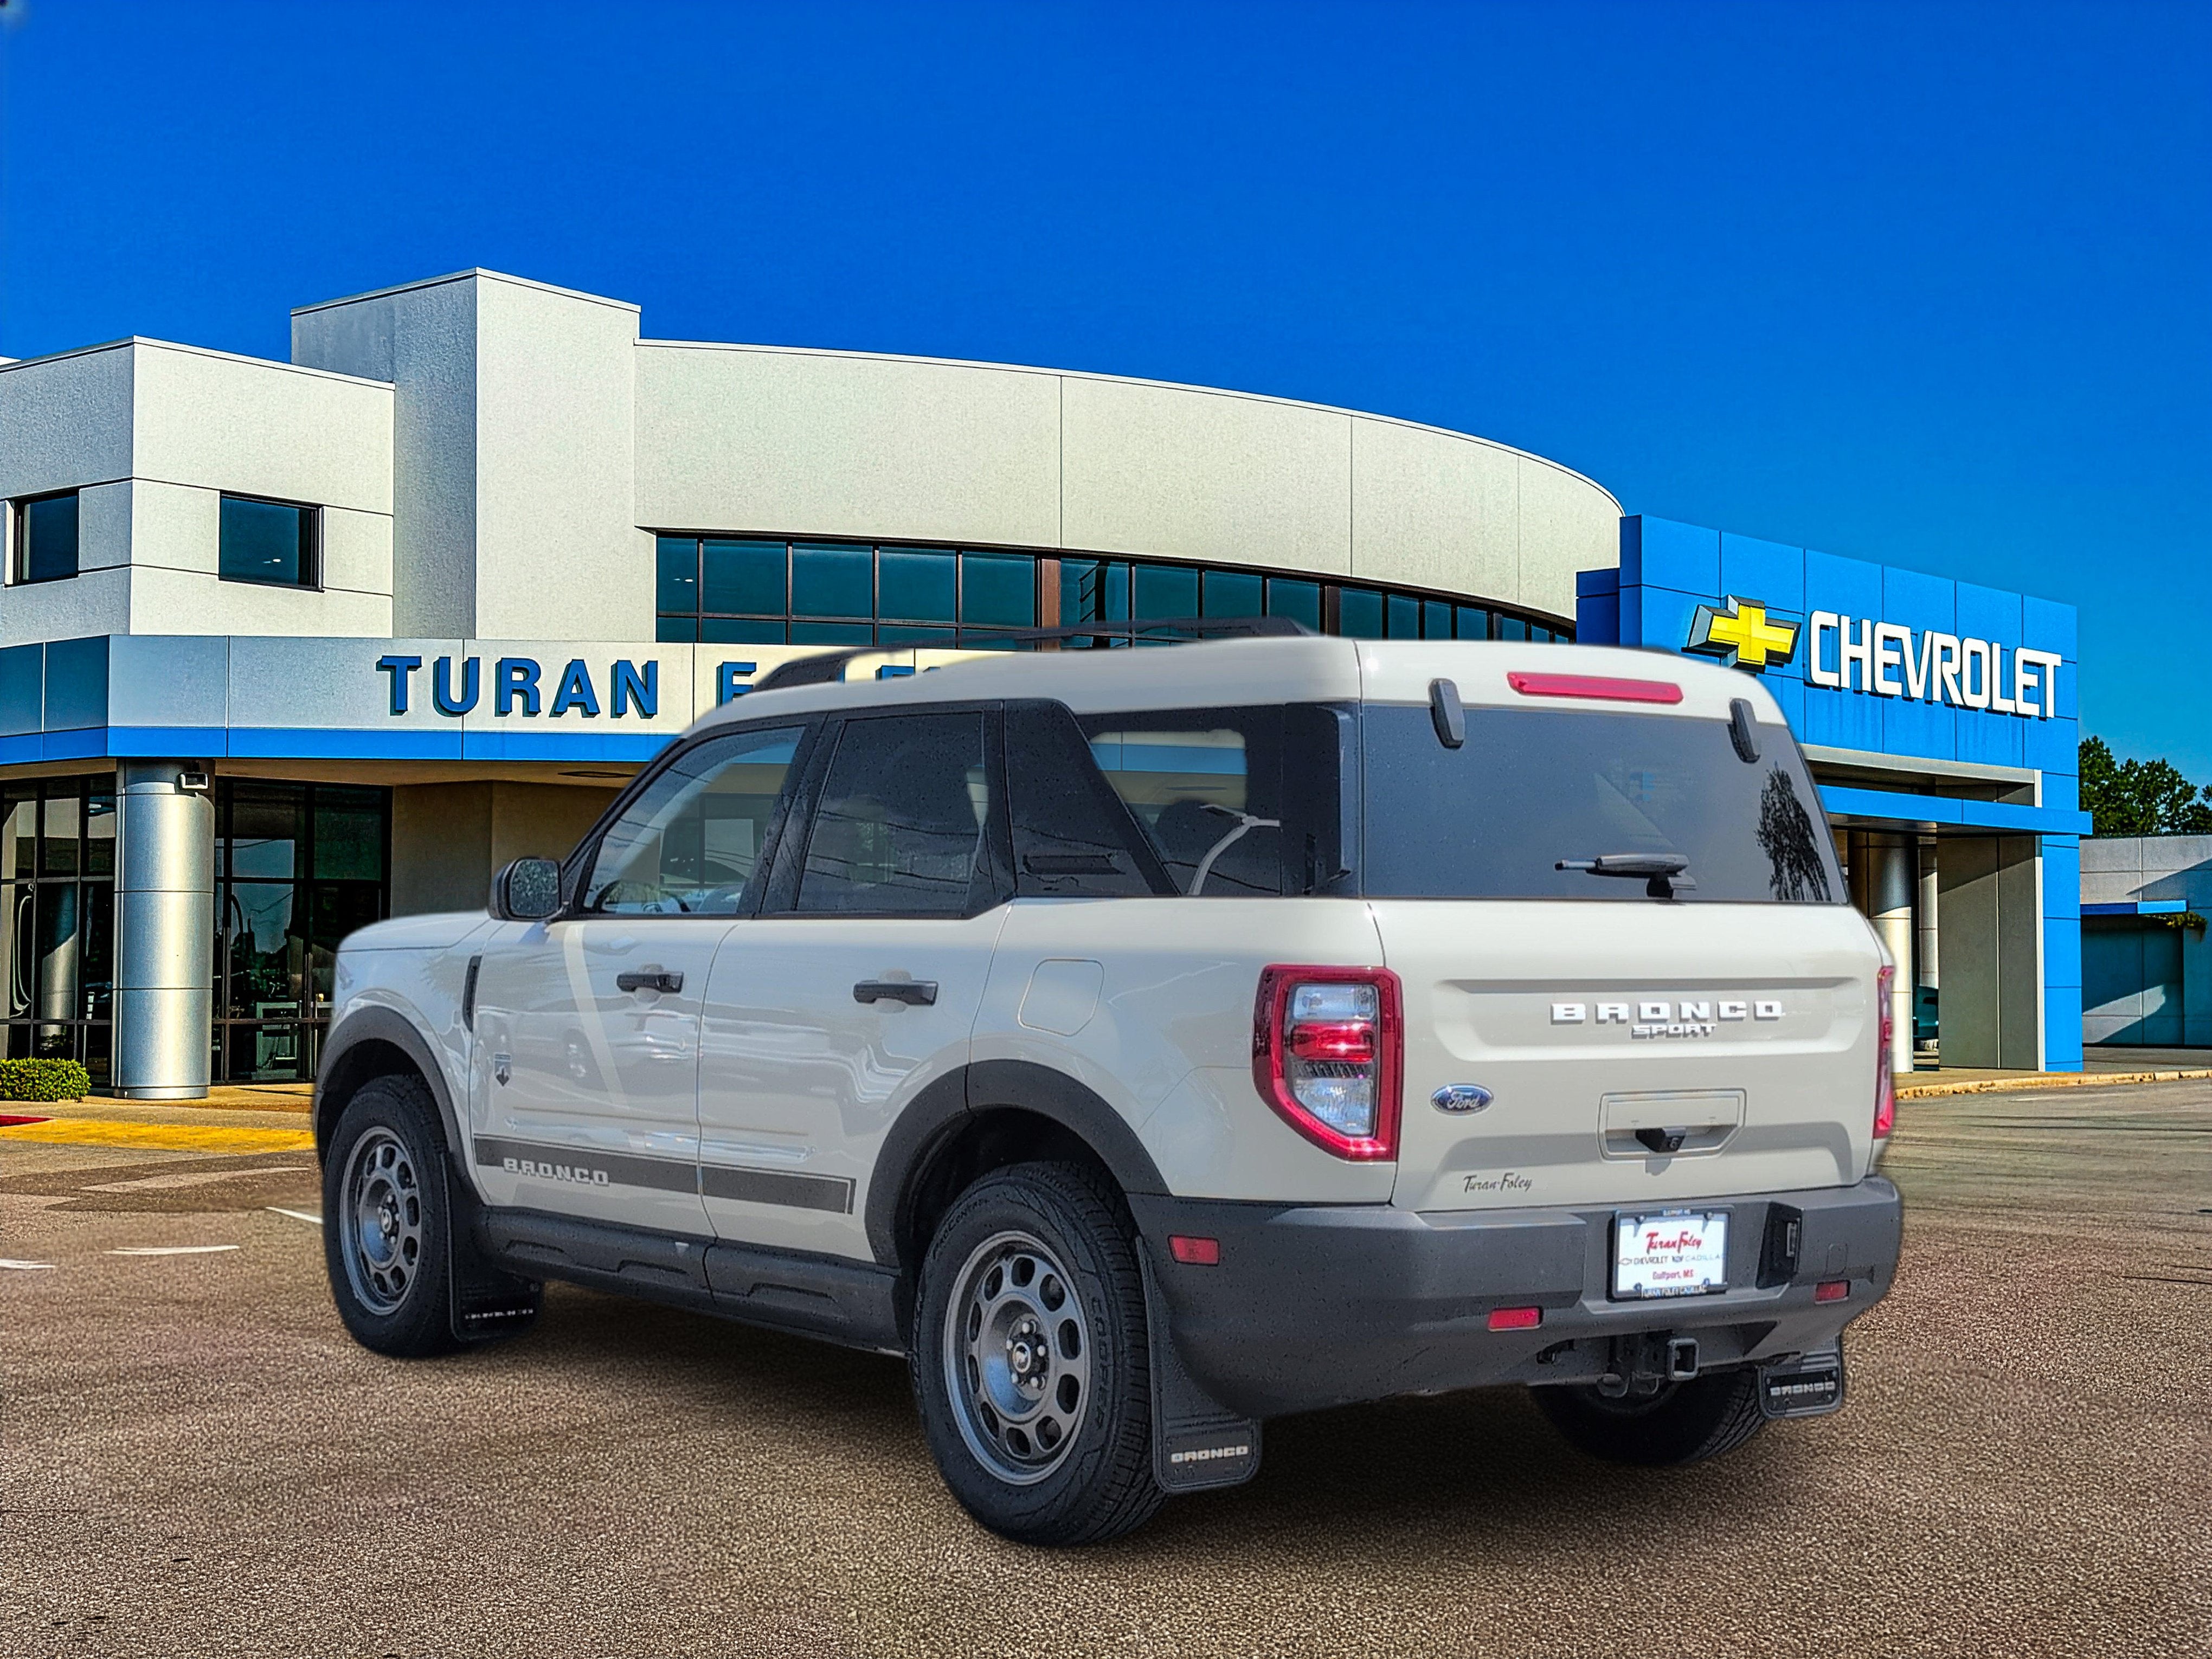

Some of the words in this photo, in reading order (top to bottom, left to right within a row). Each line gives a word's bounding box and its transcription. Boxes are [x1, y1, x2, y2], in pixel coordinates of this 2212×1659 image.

[1810, 610, 2061, 718] CHEVROLET
[377, 655, 658, 719] TURAN
[1551, 1000, 1783, 1025] BRONCO
[1631, 1023, 1718, 1039] SPORT
[503, 1157, 610, 1187] BRONCO
[1770, 1381, 1836, 1396] BRONCO
[1171, 1445, 1248, 1463] BRONCO
